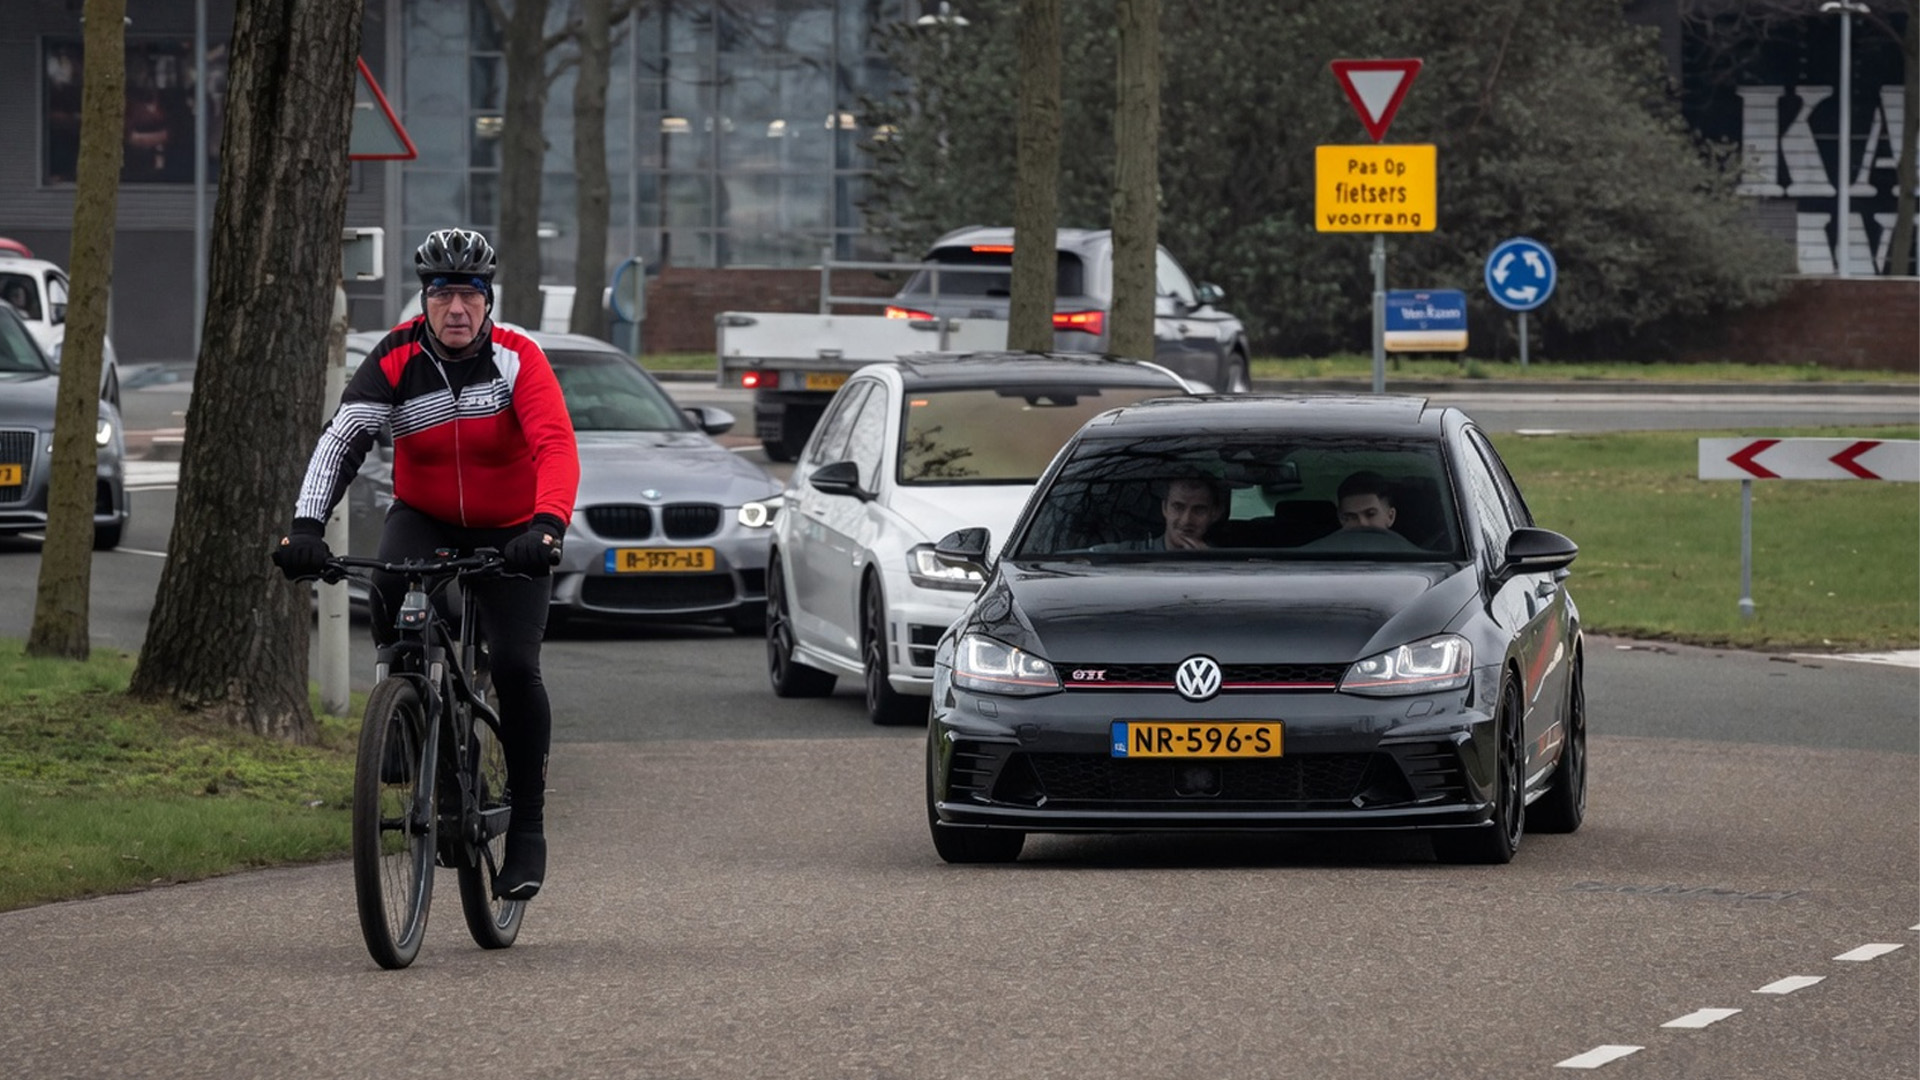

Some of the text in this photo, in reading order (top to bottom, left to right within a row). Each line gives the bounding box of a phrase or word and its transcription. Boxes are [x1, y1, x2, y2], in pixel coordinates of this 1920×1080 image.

[1348, 159, 1406, 176] Pas Op
[1335, 182, 1407, 204] fietsers
[1326, 213, 1421, 227] voorrang
[1135, 727, 1272, 753] NR-596-S
